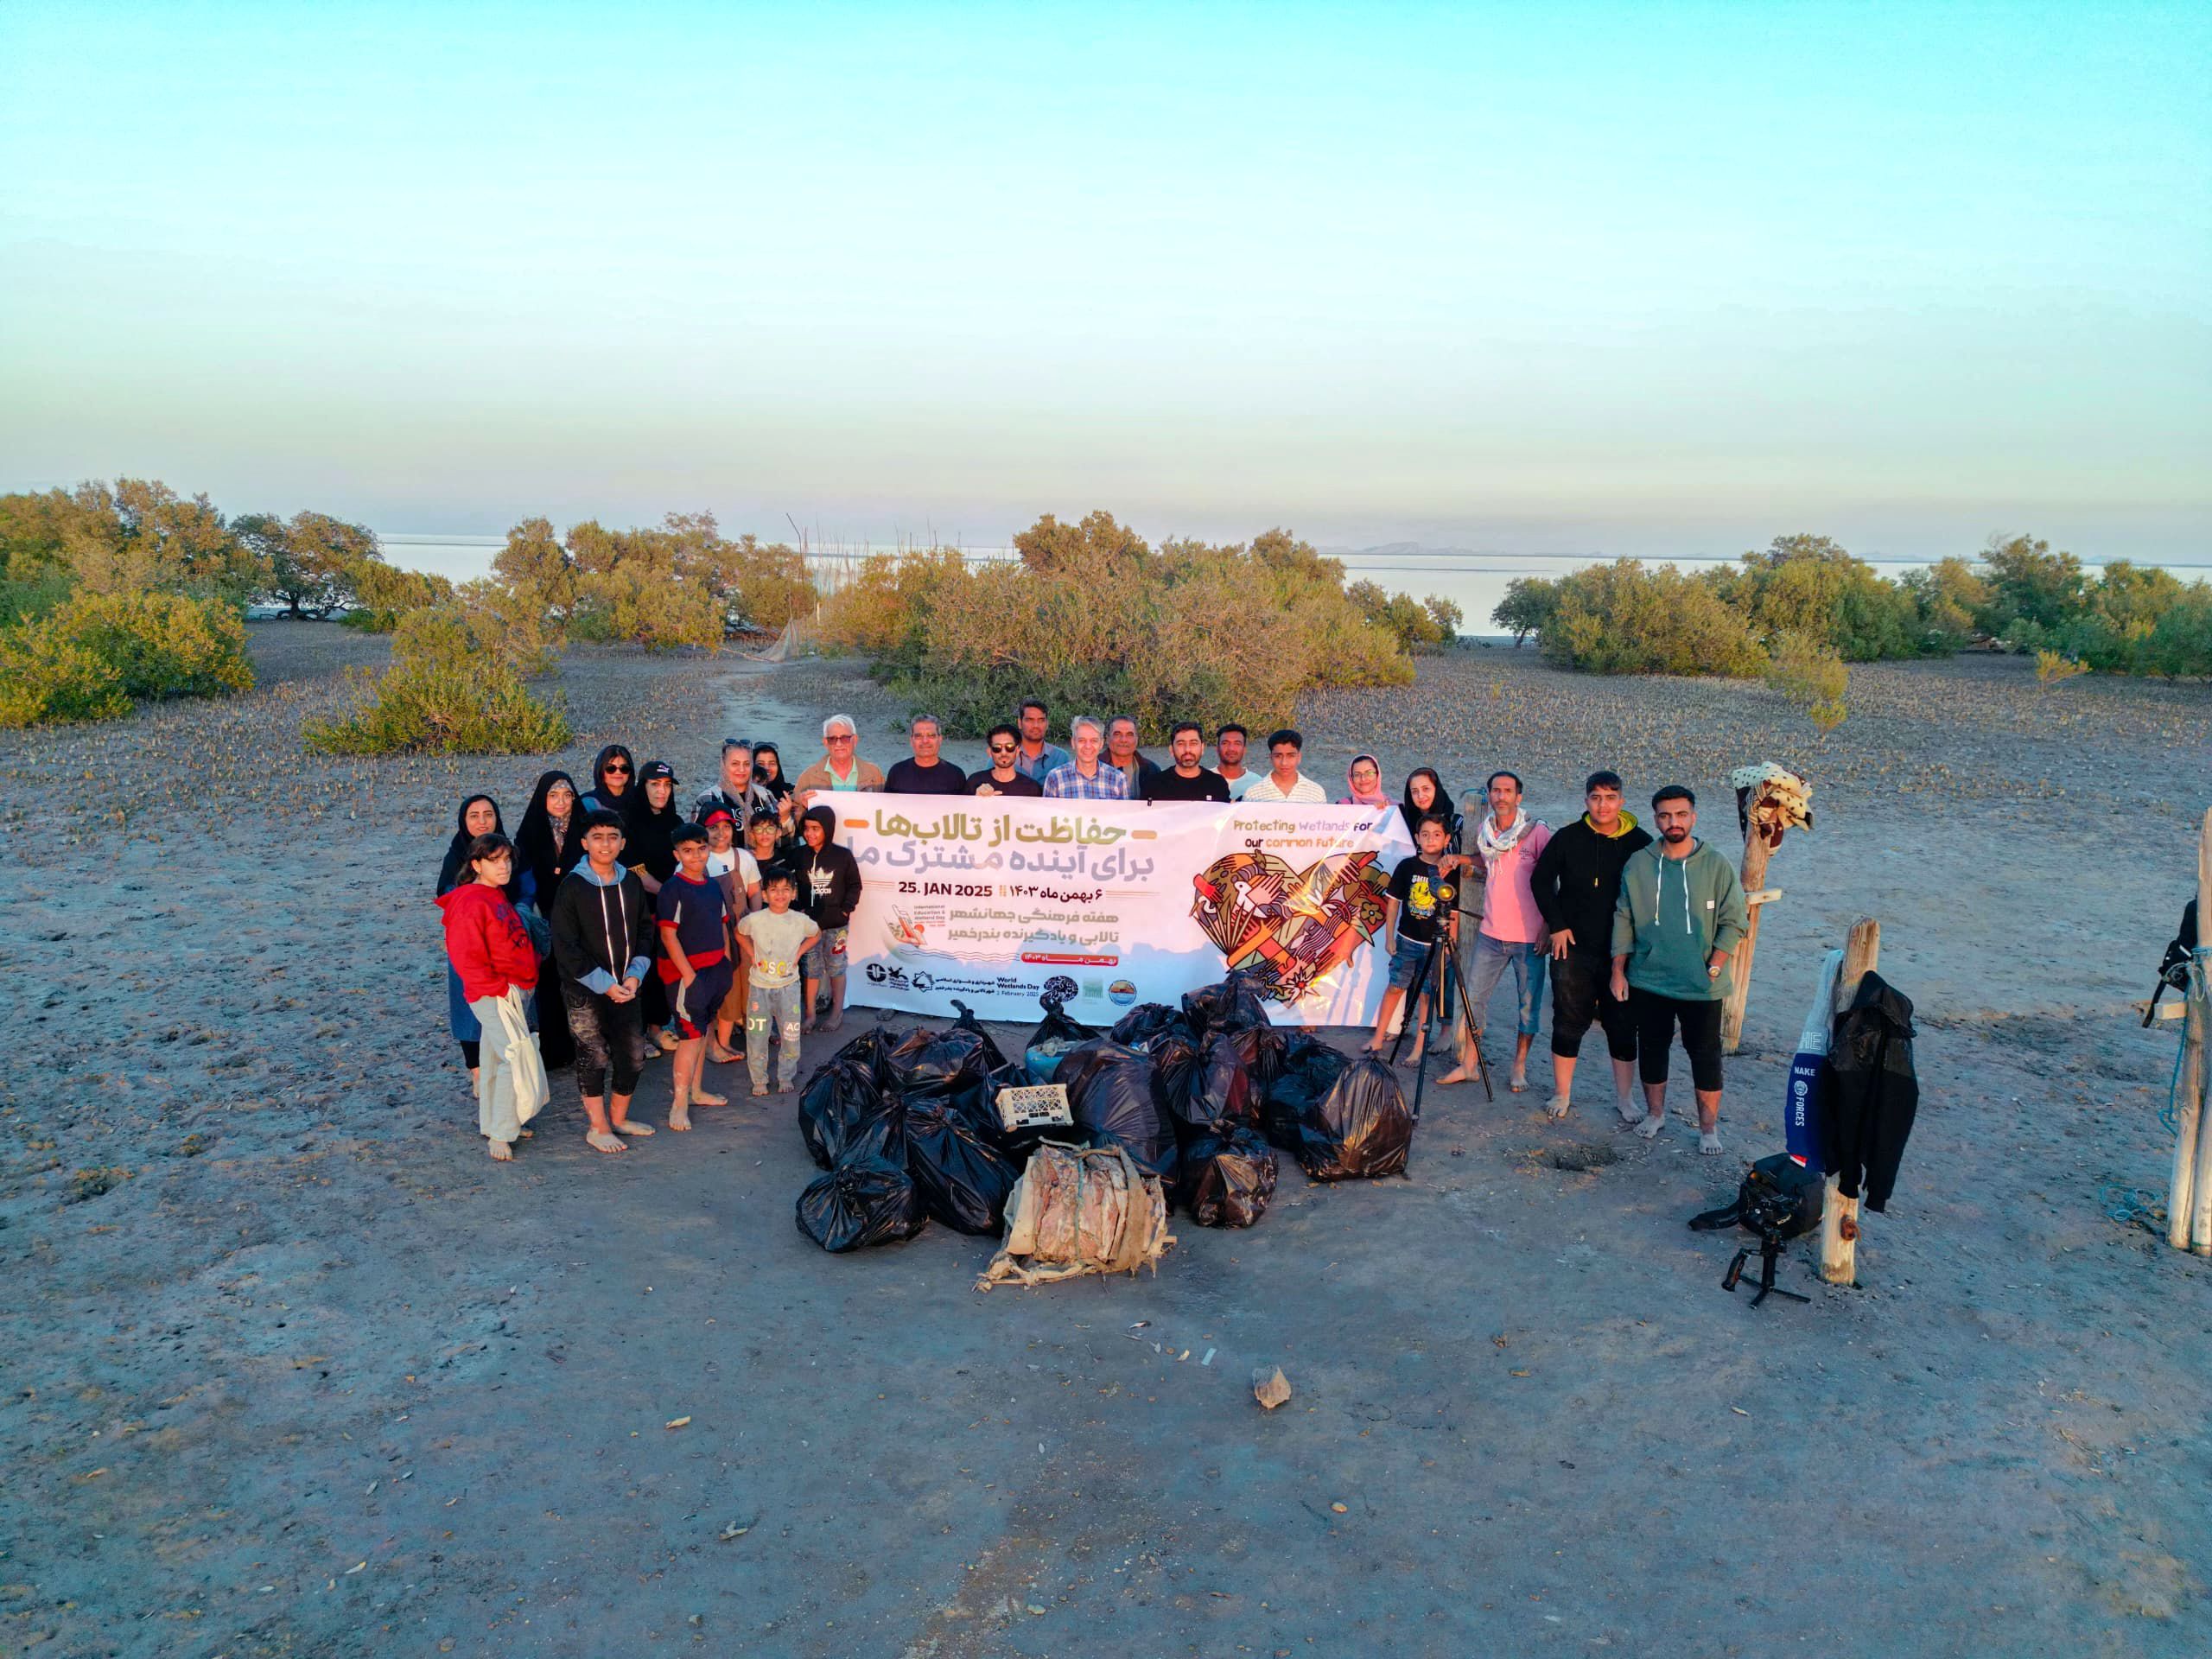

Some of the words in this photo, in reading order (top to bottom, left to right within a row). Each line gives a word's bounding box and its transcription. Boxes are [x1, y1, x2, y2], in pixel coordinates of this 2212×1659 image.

[988, 815, 1010, 847] از
[1016, 817, 1127, 844] حفاظت
[1233, 819, 1295, 833] Protecting
[847, 836, 880, 865] ما
[886, 840, 1003, 874] مشترک
[1009, 845, 1088, 880] آینده
[1091, 848, 1154, 881] برای
[899, 881, 920, 893] 25.
[924, 882, 951, 896] JAN
[955, 884, 993, 897] 2025
[1009, 885, 1039, 897] ۱۴۰۳
[1040, 887, 1058, 899] ماه
[1095, 888, 1103, 900] ۶
[1060, 892, 1093, 904] بهمن
[1018, 907, 1080, 925] فرهنگی
[1082, 912, 1119, 923] هفته
[1003, 928, 1066, 944] یادگیرنده
[1069, 934, 1077, 944] و
[1079, 931, 1119, 946] تالابی
[1796, 1096, 1805, 1127] FORCES
